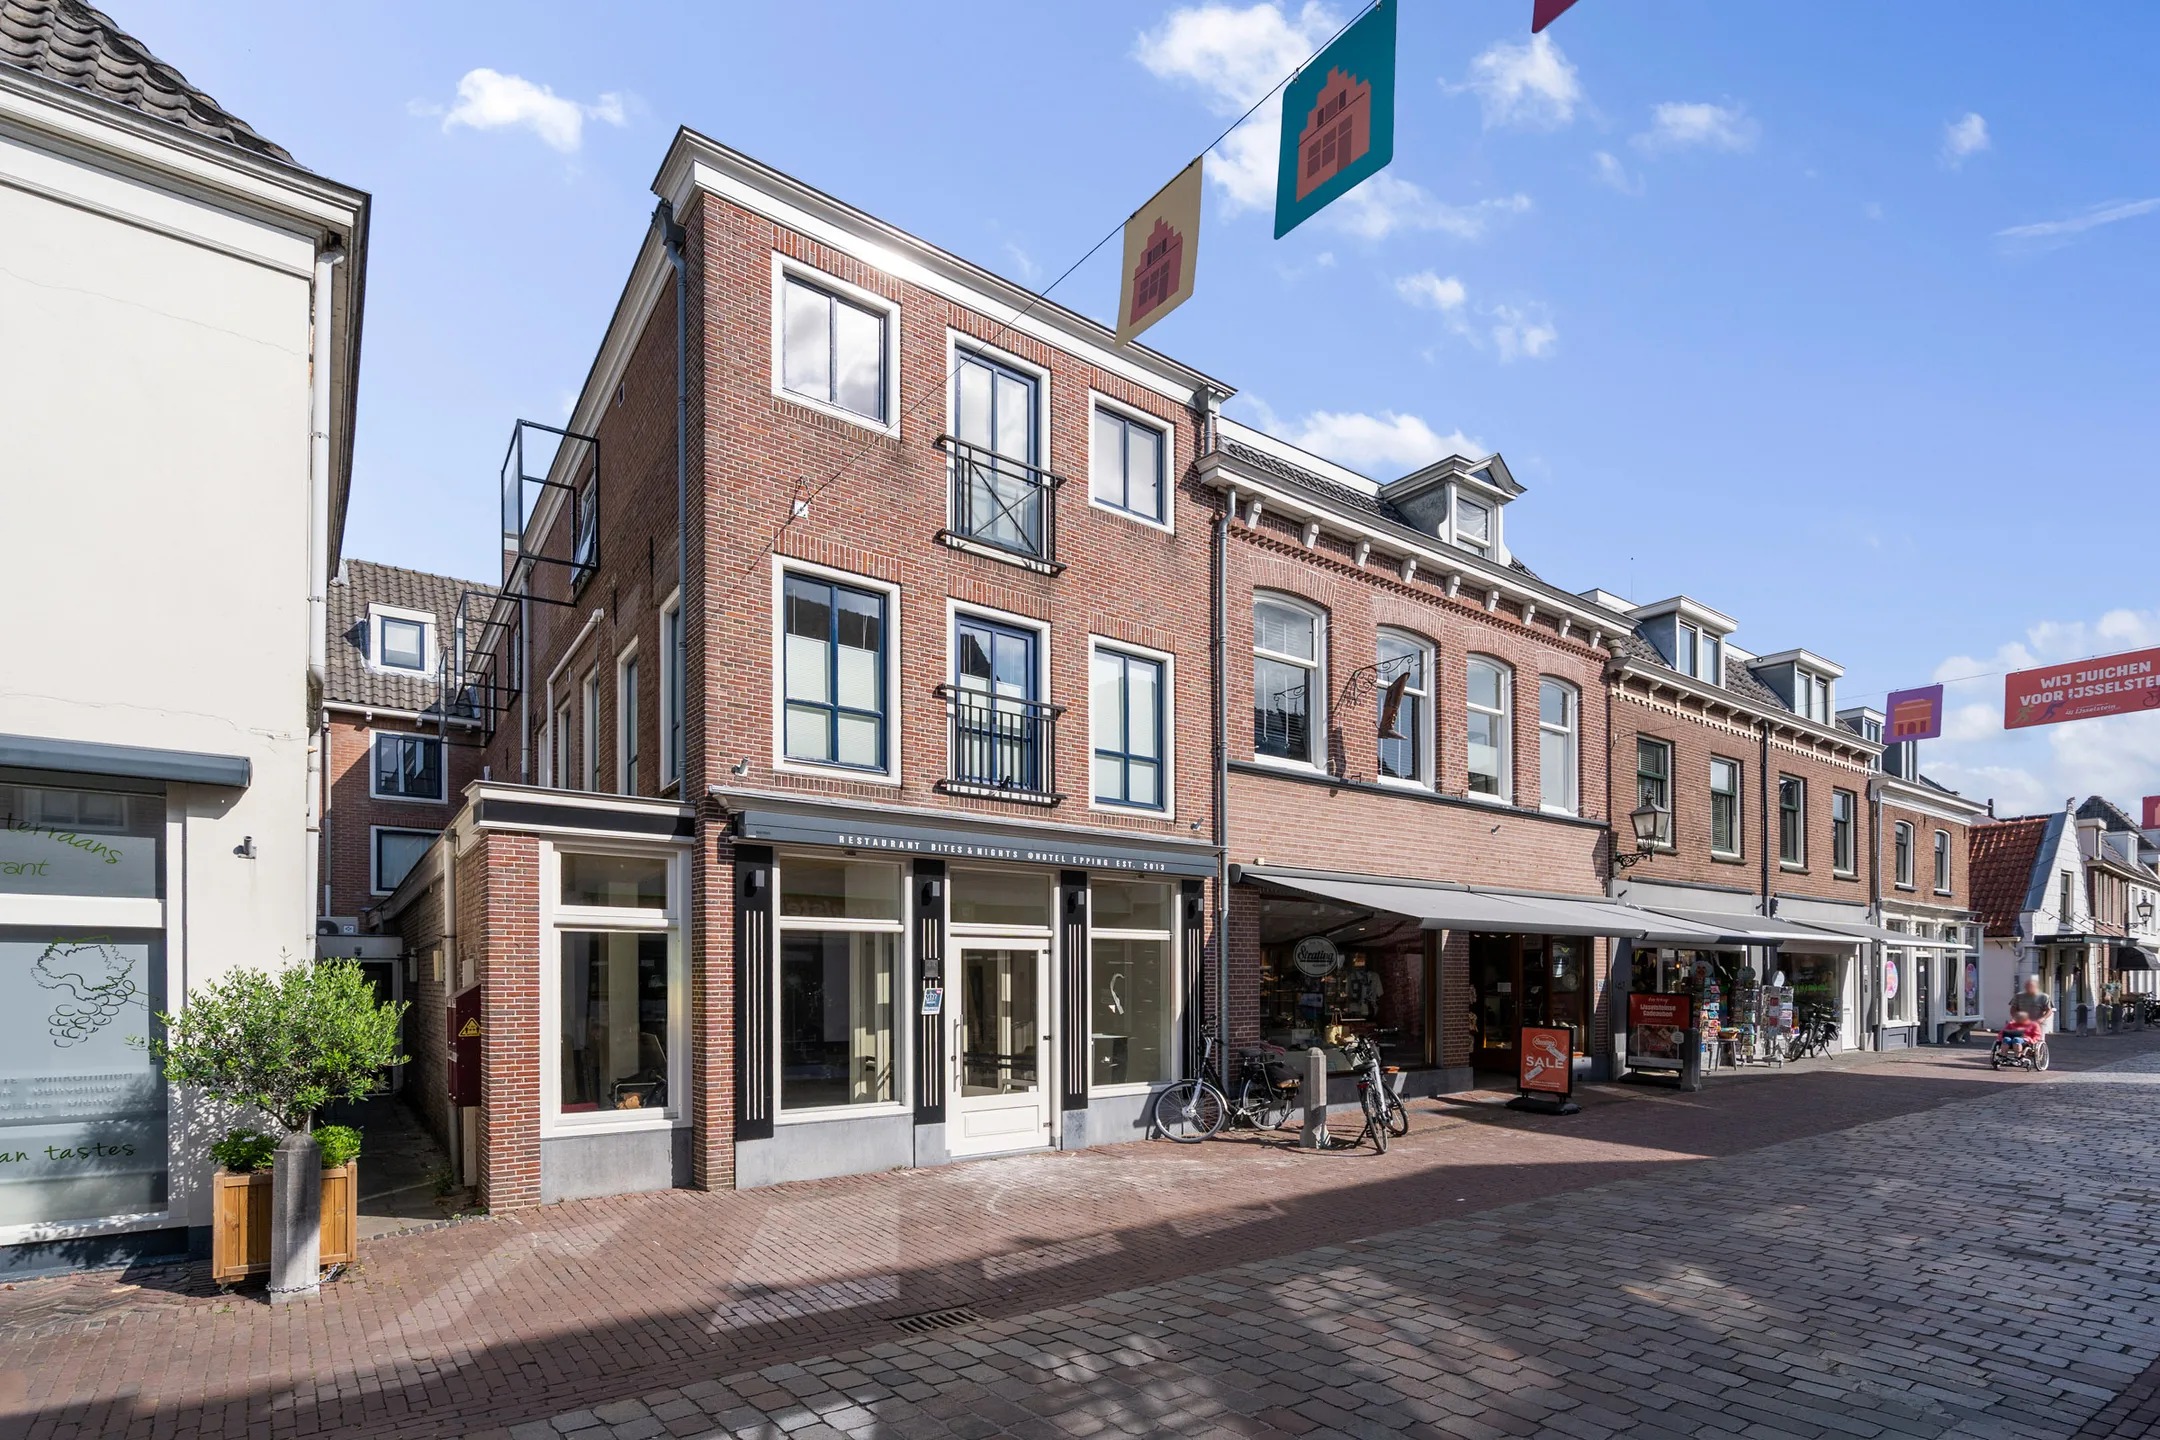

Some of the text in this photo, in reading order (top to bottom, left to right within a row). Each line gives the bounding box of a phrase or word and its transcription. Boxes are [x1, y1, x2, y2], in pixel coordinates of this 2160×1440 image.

[2040, 660, 2152, 689] WIJ JUICHEN
[2020, 690, 2063, 706] VOOR
[838, 835, 920, 850] RESTAURANT
[931, 843, 963, 854] BITES
[977, 847, 1018, 859] NIGHTS
[1072, 856, 1109, 867] EPPING
[1116, 859, 1136, 869] EST.
[1143, 862, 1165, 871] 2013
[1525, 1055, 1565, 1069] SALE
[44, 1142, 137, 1161] tastes
